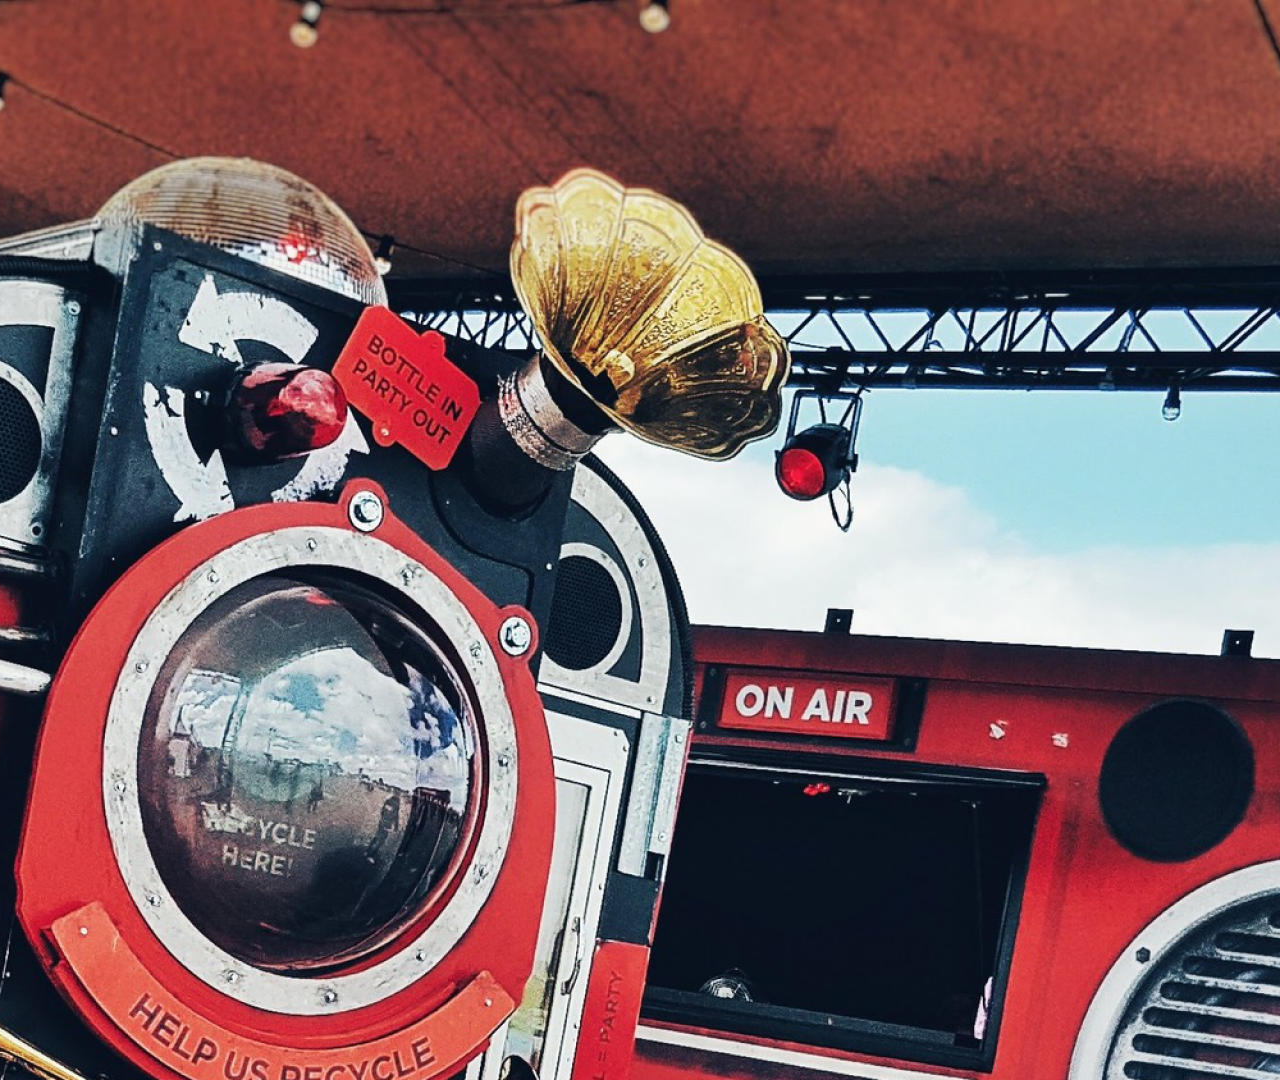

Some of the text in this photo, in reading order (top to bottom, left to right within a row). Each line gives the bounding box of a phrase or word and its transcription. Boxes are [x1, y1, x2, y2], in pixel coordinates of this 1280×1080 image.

[352, 358, 451, 444] PARTY OUT
[367, 335, 463, 421] BOTTLE IN
[735, 683, 872, 725] ON AIR
[129, 993, 217, 1065] HELP
[601, 970, 624, 1043] PARTY
